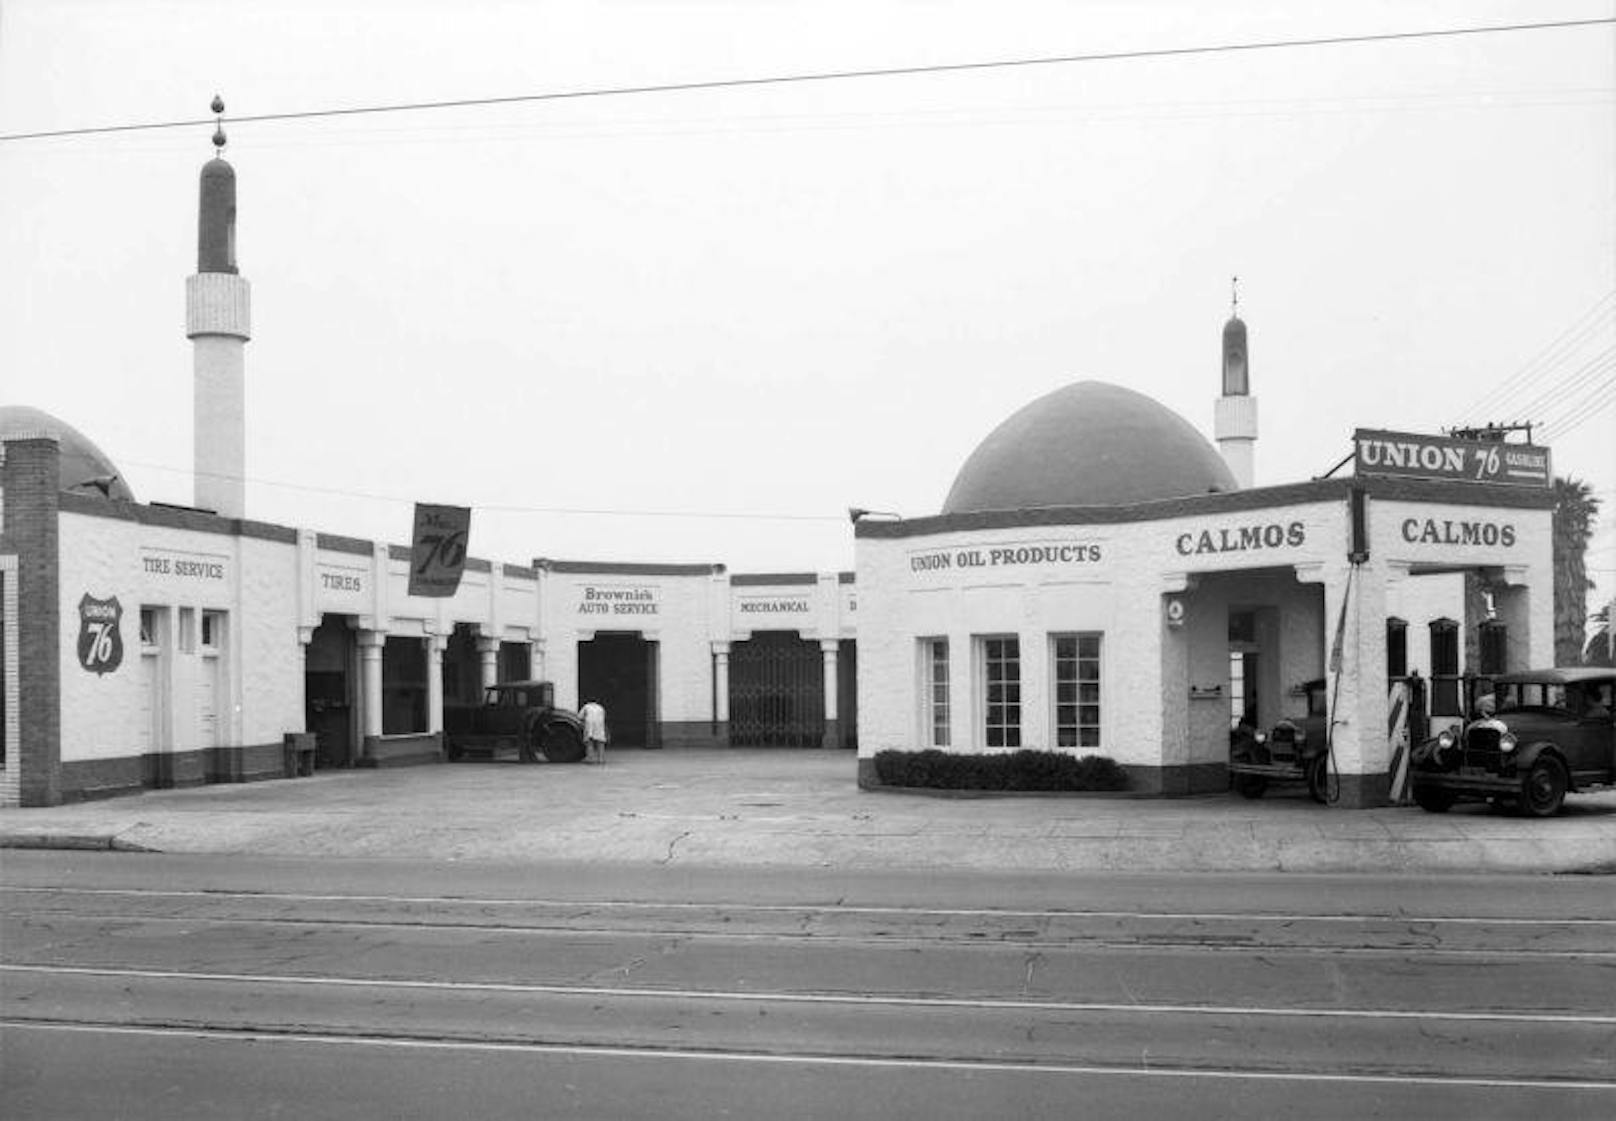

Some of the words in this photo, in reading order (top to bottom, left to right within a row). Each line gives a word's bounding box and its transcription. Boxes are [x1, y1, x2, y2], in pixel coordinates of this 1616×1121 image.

[1358, 439, 1465, 472] UNION
[1475, 446, 1500, 480] 76
[1176, 522, 1306, 556] CALMOS
[1402, 518, 1516, 547] CALMOS
[418, 530, 466, 574] 76
[910, 553, 951, 572] UNION
[957, 551, 986, 568] OIL
[990, 545, 1101, 566] PRODUCTS
[143, 557, 170, 575] TIRE
[175, 560, 224, 579] SERVICE
[320, 573, 361, 592] TIRES
[85, 605, 116, 619] UNION
[578, 602, 609, 615] AUTO
[614, 602, 658, 615] SERVICE
[740, 601, 809, 613] MECHANICAL
[86, 623, 114, 666] 76
